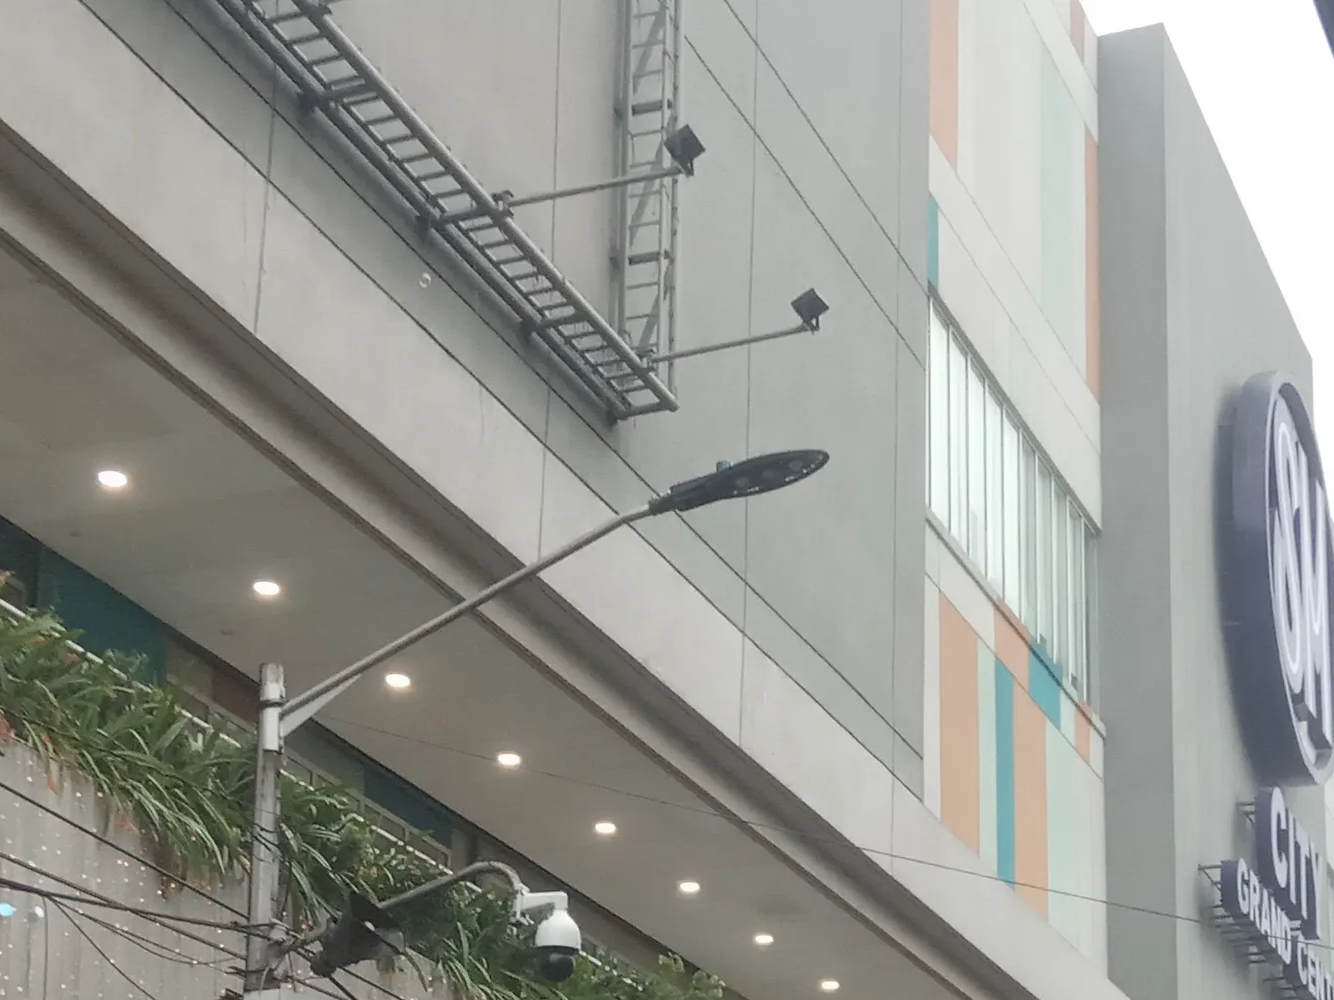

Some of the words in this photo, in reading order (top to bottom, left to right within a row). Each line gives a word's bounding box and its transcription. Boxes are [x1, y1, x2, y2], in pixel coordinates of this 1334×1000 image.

[1271, 392, 1332, 750] SM
[1237, 857, 1292, 965] GRAND
[1269, 786, 1324, 939] CITY
